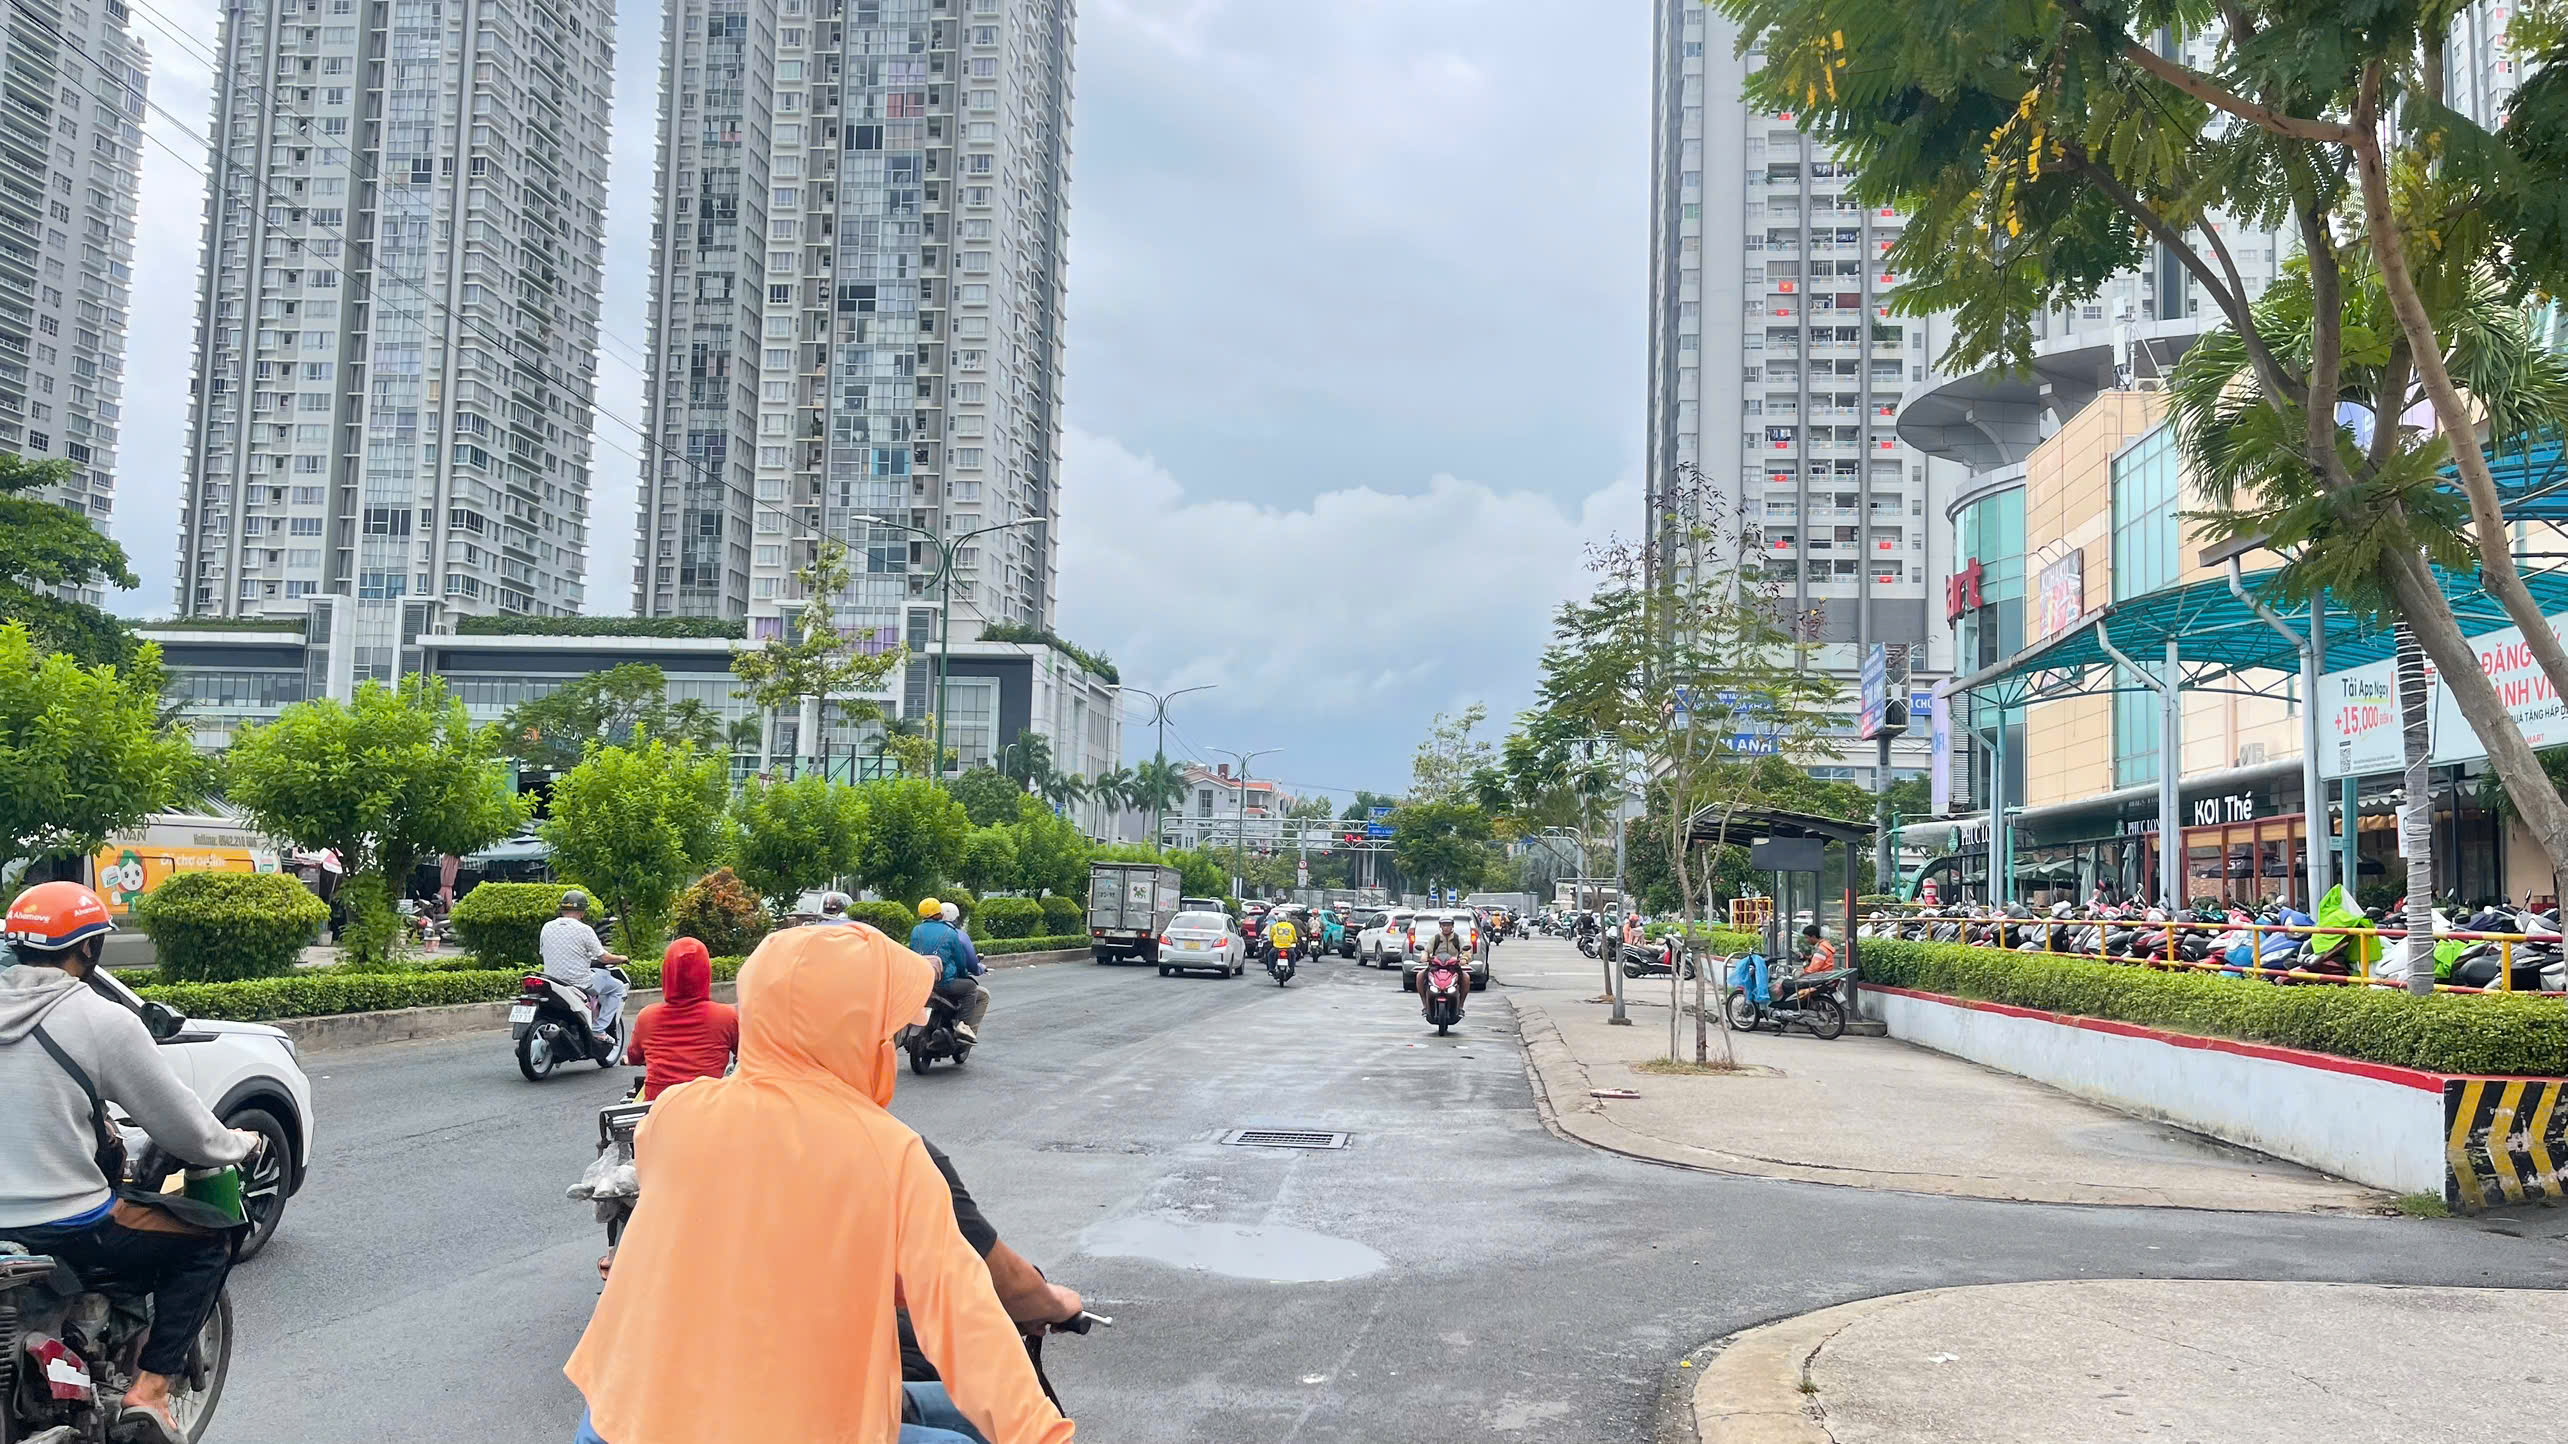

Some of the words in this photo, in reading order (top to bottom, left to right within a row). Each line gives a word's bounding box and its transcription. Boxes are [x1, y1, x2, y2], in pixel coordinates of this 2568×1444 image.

[2342, 677, 2357, 697] Tải
[2358, 680, 2373, 701] App
[2335, 706, 2379, 736] +15,000
[2194, 798, 2219, 826] KOI
[2224, 791, 2252, 822] Thé
